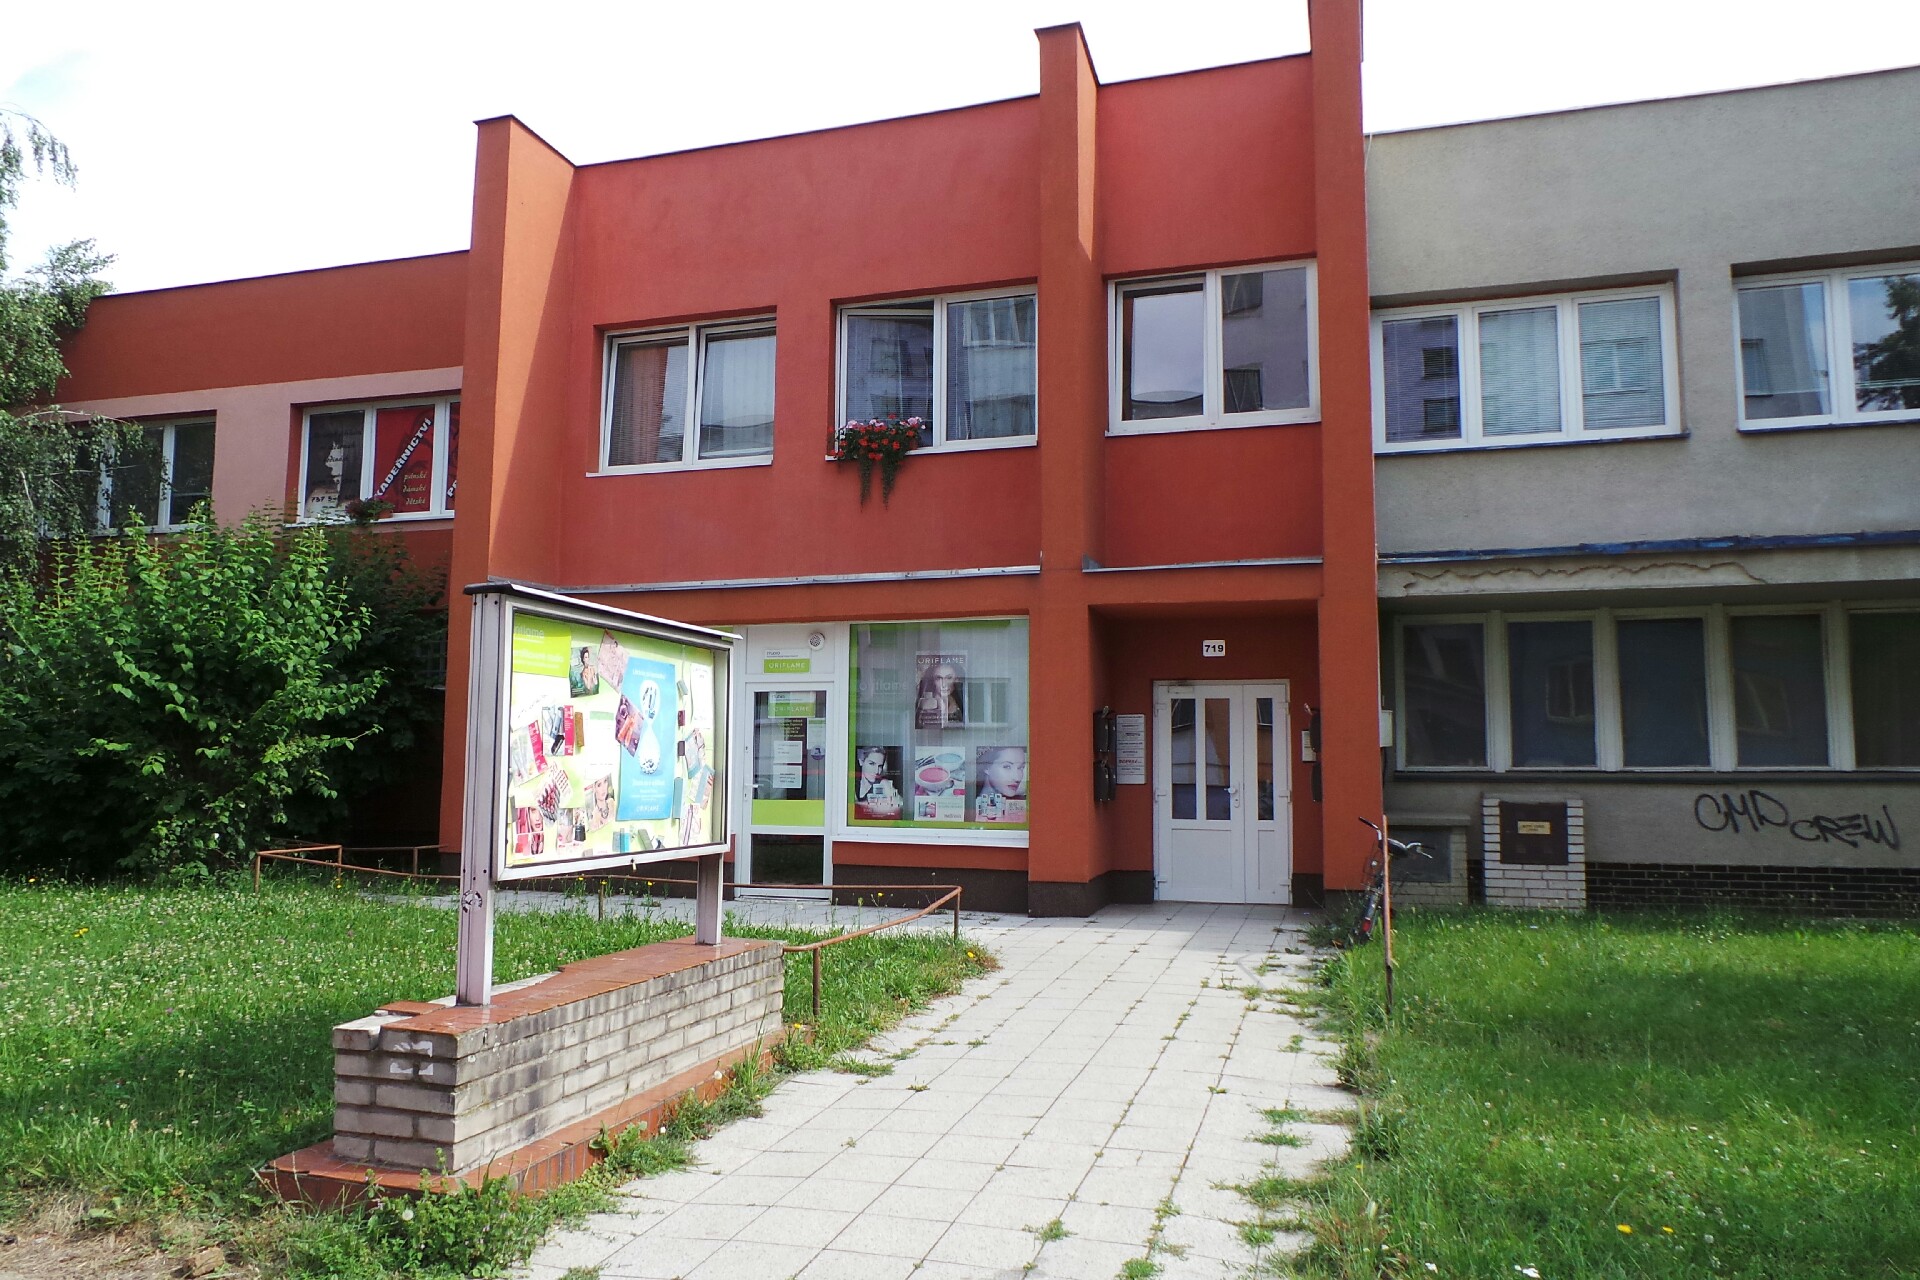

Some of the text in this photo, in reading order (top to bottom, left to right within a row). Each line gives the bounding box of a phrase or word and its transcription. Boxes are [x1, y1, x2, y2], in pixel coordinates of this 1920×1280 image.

[1204, 644, 1224, 653] 719
[917, 656, 965, 664] ORIFLAME
[1789, 804, 1901, 851] CREW
